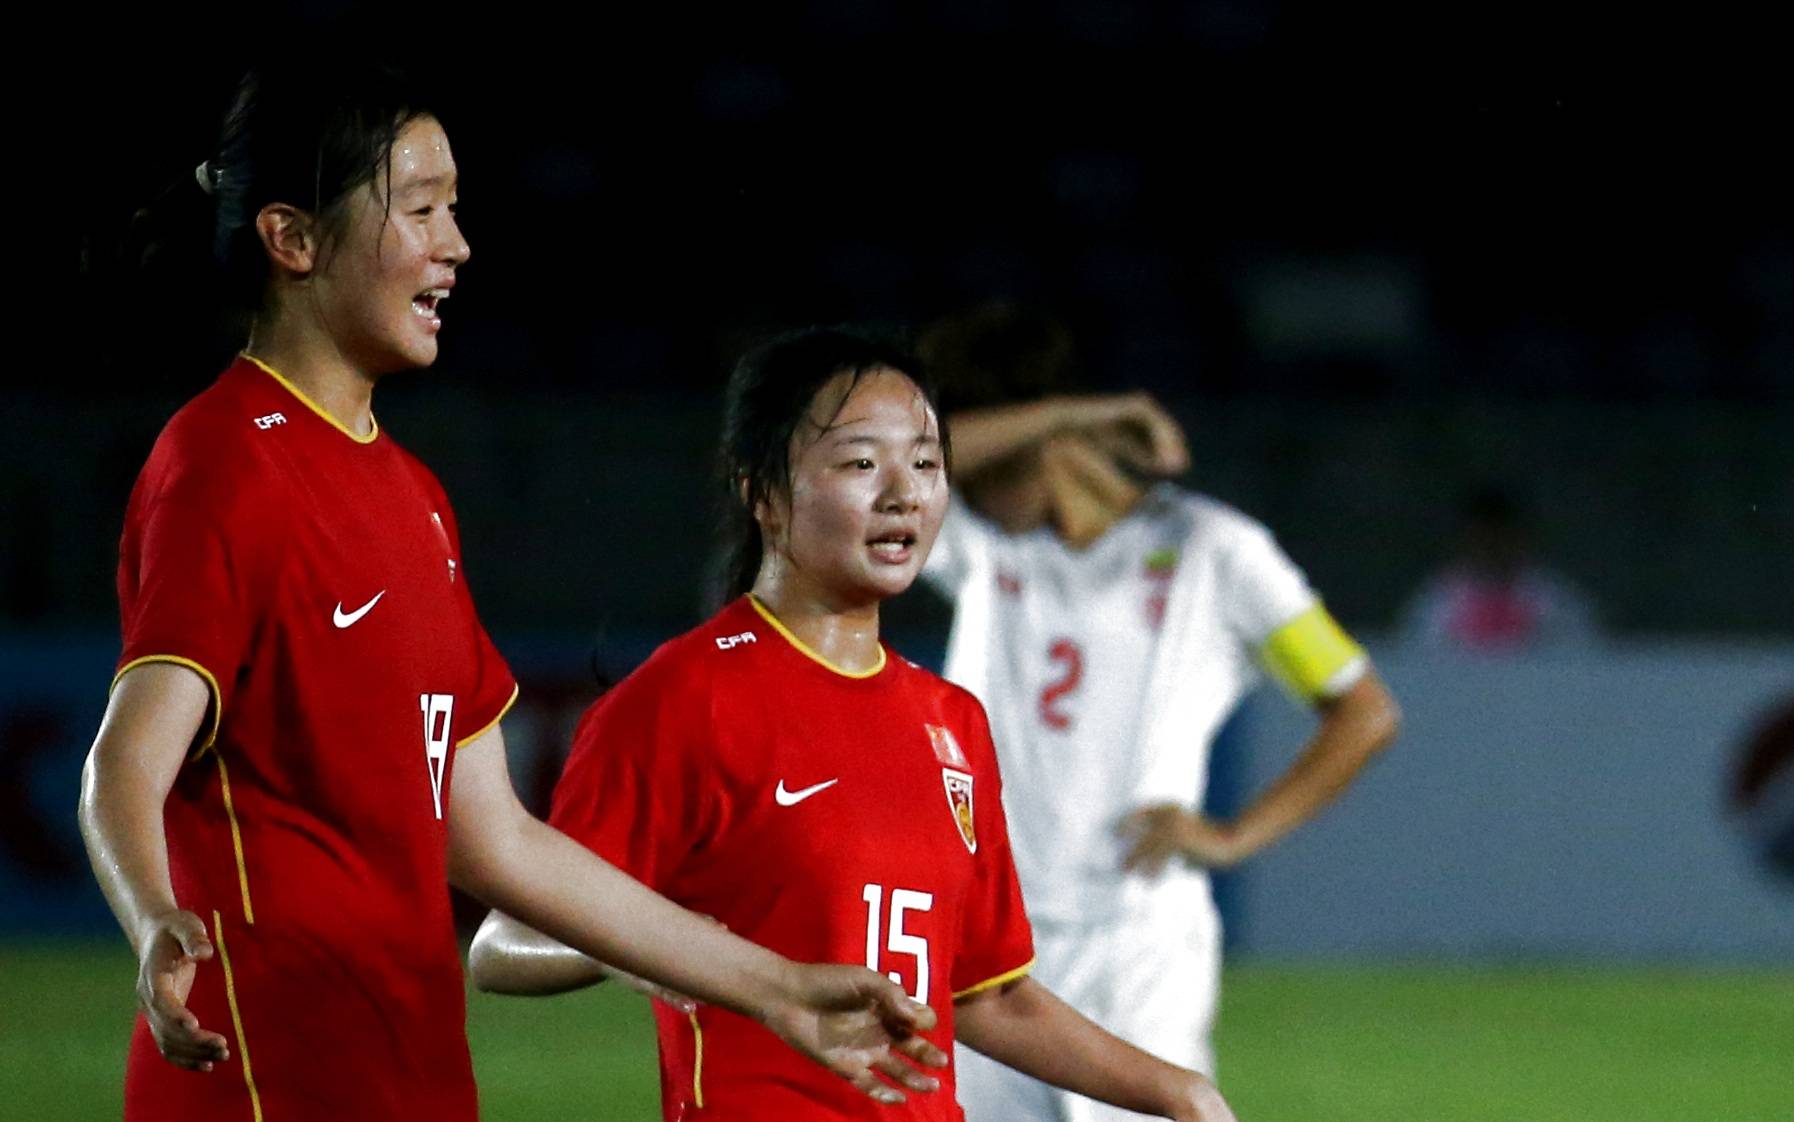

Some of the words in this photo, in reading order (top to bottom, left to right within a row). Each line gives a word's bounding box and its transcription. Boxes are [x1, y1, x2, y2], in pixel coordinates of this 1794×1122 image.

[254, 412, 287, 430] CFA
[715, 631, 757, 650] CFA
[1036, 635, 1085, 731] 2
[863, 883, 934, 1006] 15
